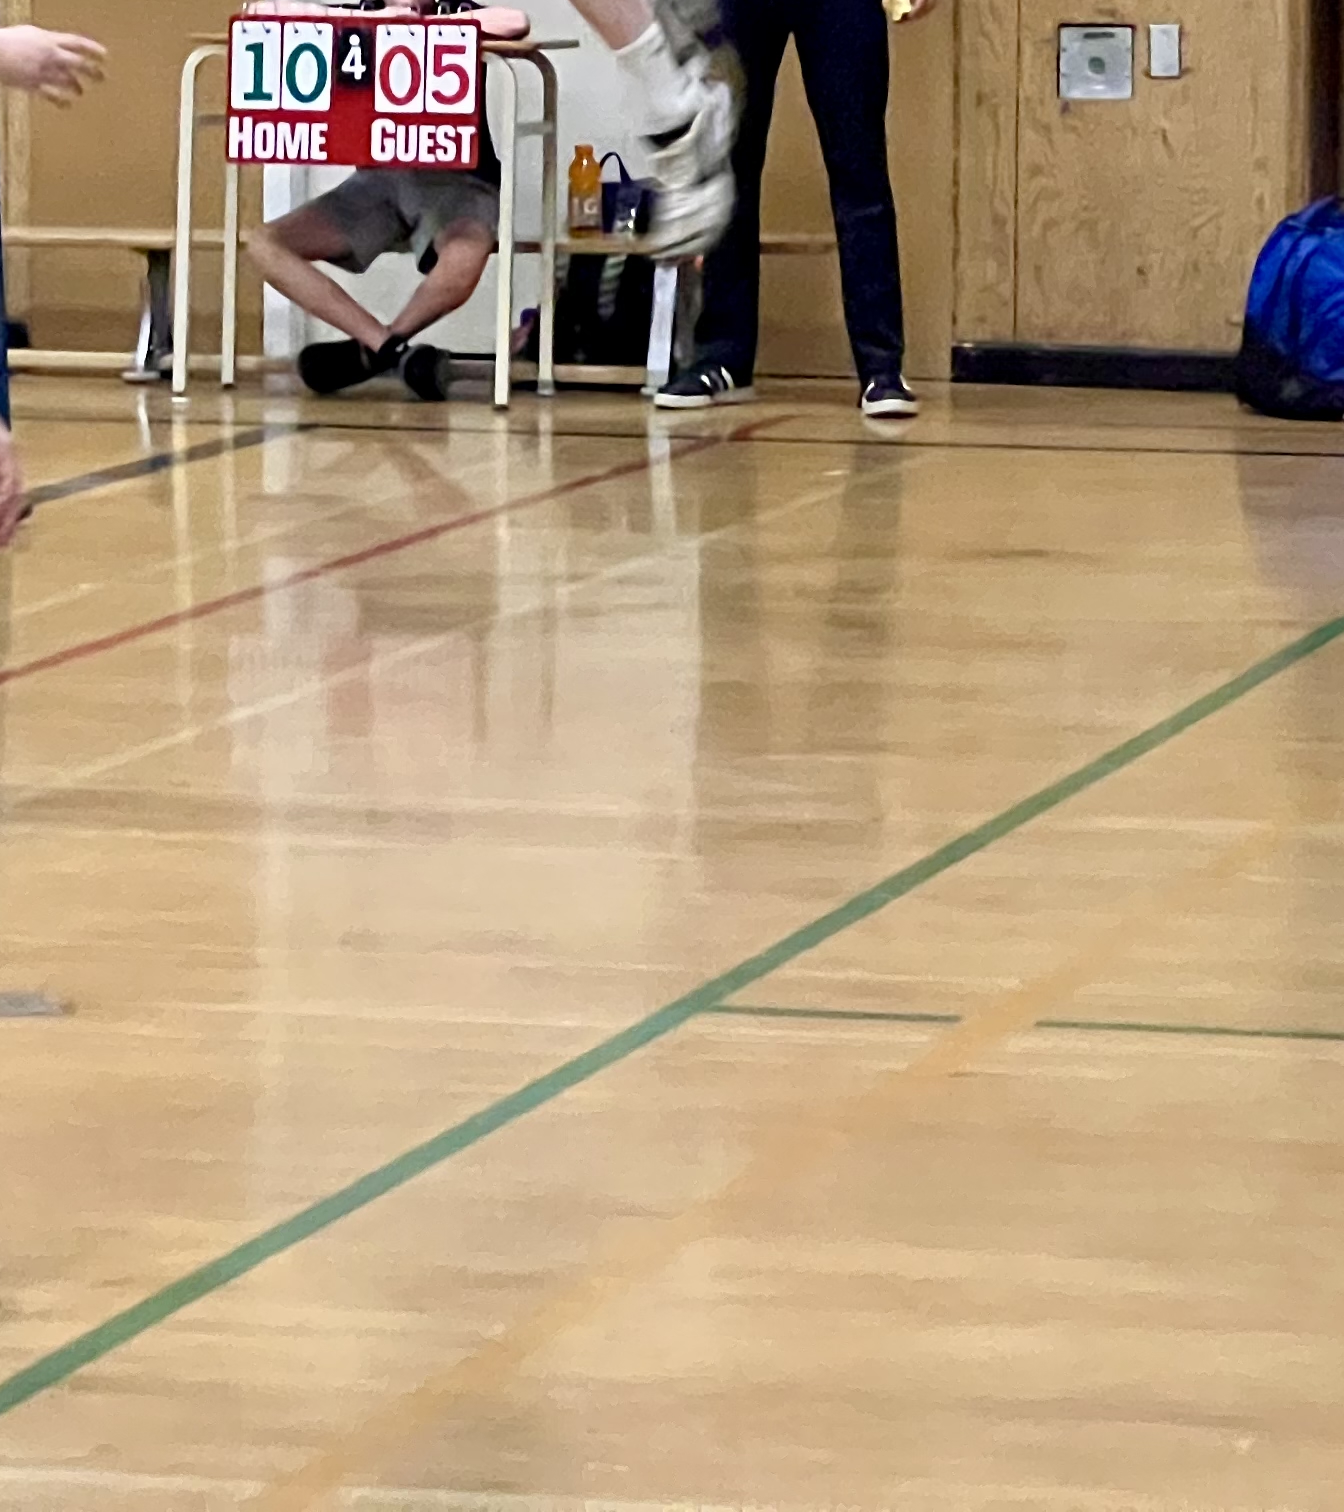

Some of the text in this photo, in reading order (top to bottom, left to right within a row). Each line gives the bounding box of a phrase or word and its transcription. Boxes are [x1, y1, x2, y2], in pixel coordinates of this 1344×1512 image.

[243, 41, 471, 106] 10 4 05
[227, 116, 478, 164] HOME GUEST
